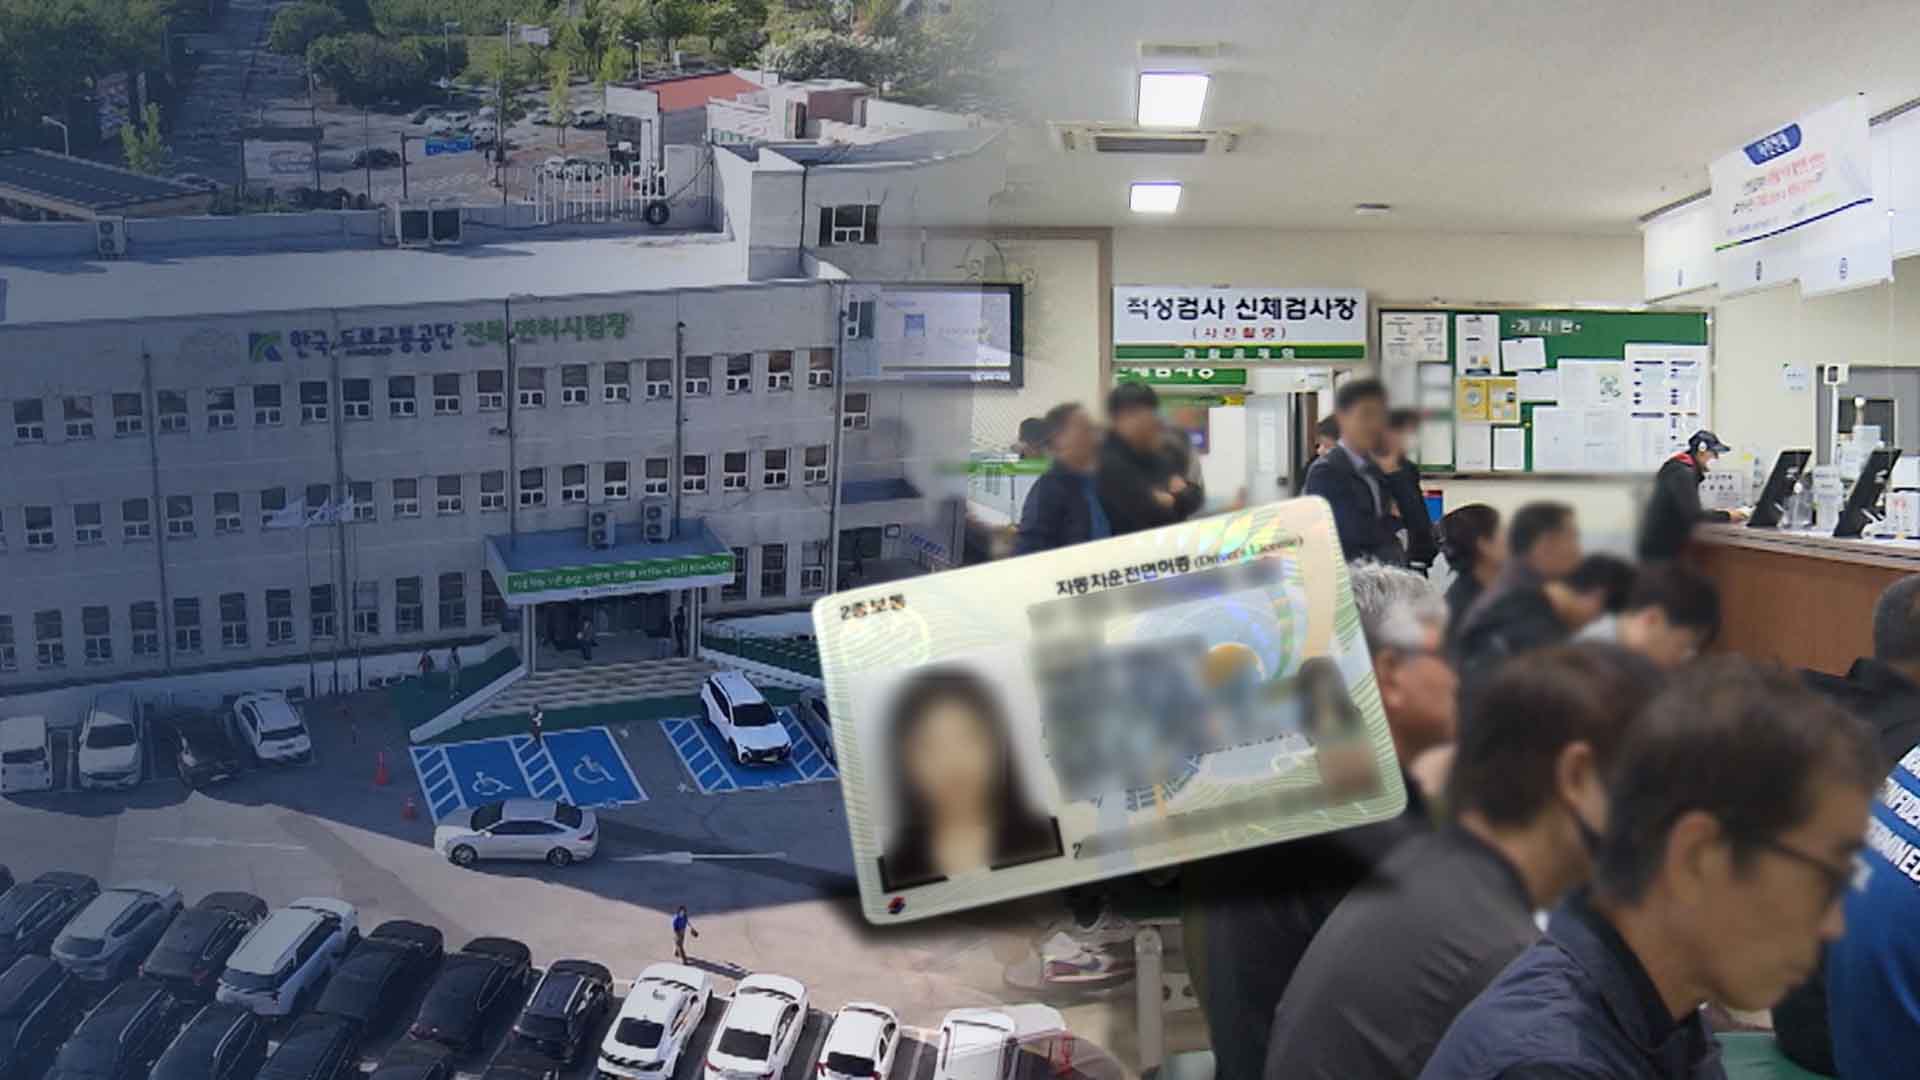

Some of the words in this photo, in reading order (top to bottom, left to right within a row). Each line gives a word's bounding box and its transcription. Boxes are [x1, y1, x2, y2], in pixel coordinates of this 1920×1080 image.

[1127, 297, 1226, 321] 적성검사
[1235, 296, 1358, 321] 신체검사장
[1056, 555, 1191, 596] 자동차운전면허증
